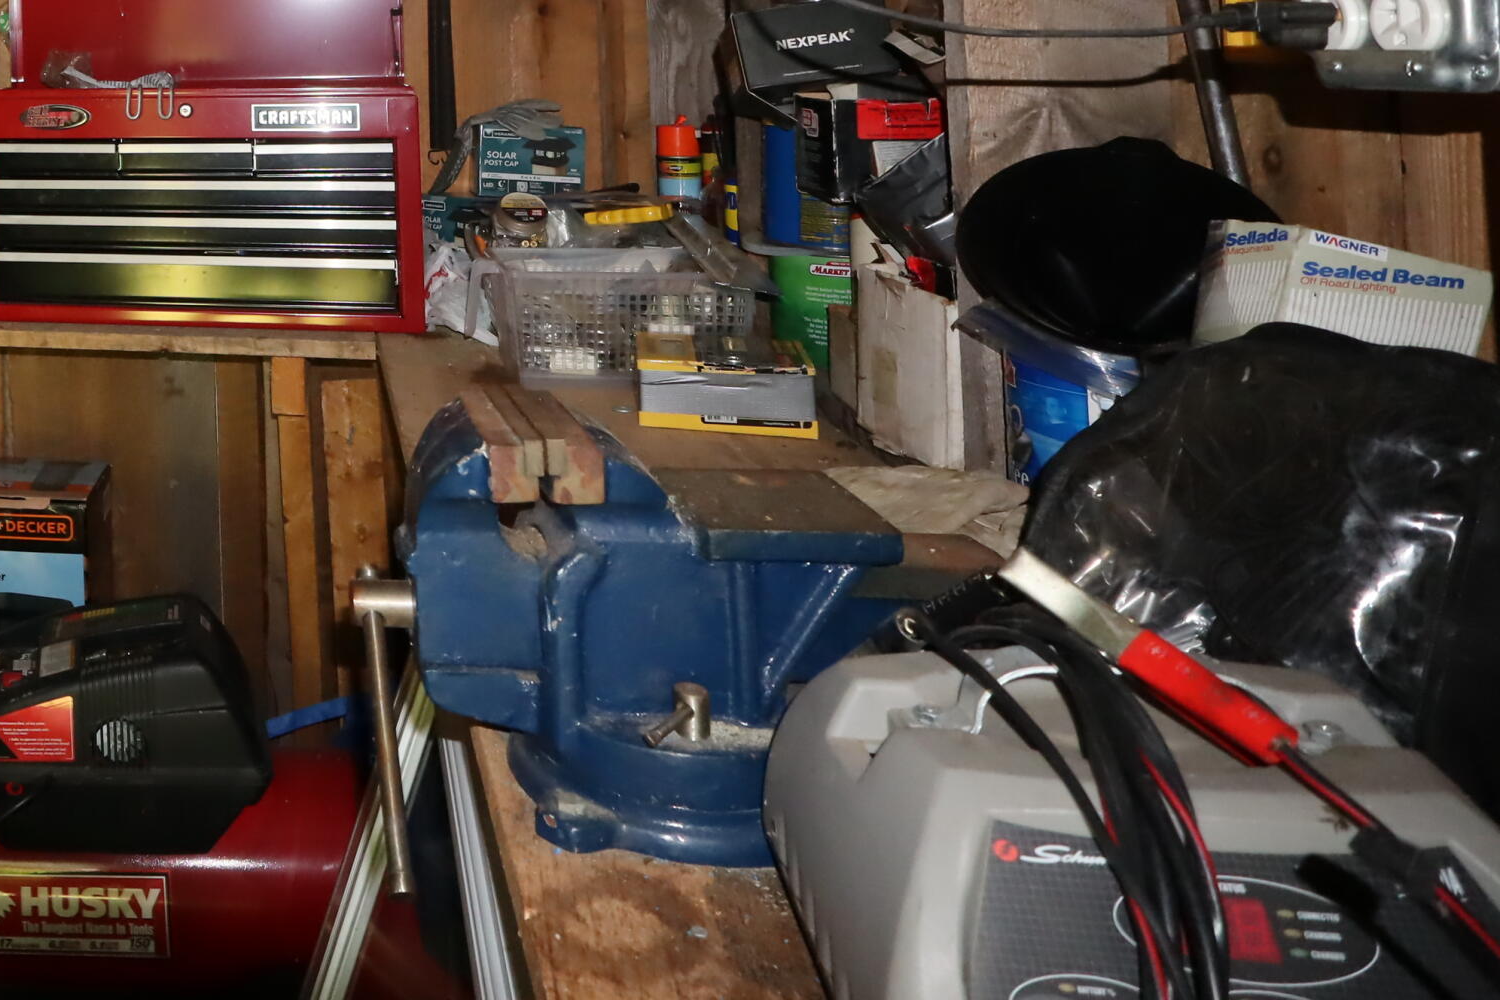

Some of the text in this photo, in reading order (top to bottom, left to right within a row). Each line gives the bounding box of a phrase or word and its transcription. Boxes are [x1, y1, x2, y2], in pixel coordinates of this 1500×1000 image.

[775, 30, 851, 51] NEXPEAK
[258, 110, 353, 125] CRAFTSMAN
[486, 150, 517, 160] SOLAR
[483, 159, 502, 167] POST
[1226, 228, 1288, 247] Sellada
[1315, 232, 1380, 256] WAGNER
[1302, 261, 1465, 290] Sealed Beam
[1300, 276, 1397, 295] Off Road Lighting
[1218, 882, 1246, 894] TATUS
[20, 886, 161, 919] HUSKY
[1296, 911, 1340, 922] CONNECTED
[22, 921, 39, 934] The
[129, 924, 154, 936] Tools
[1310, 950, 1346, 962] CHARGED
